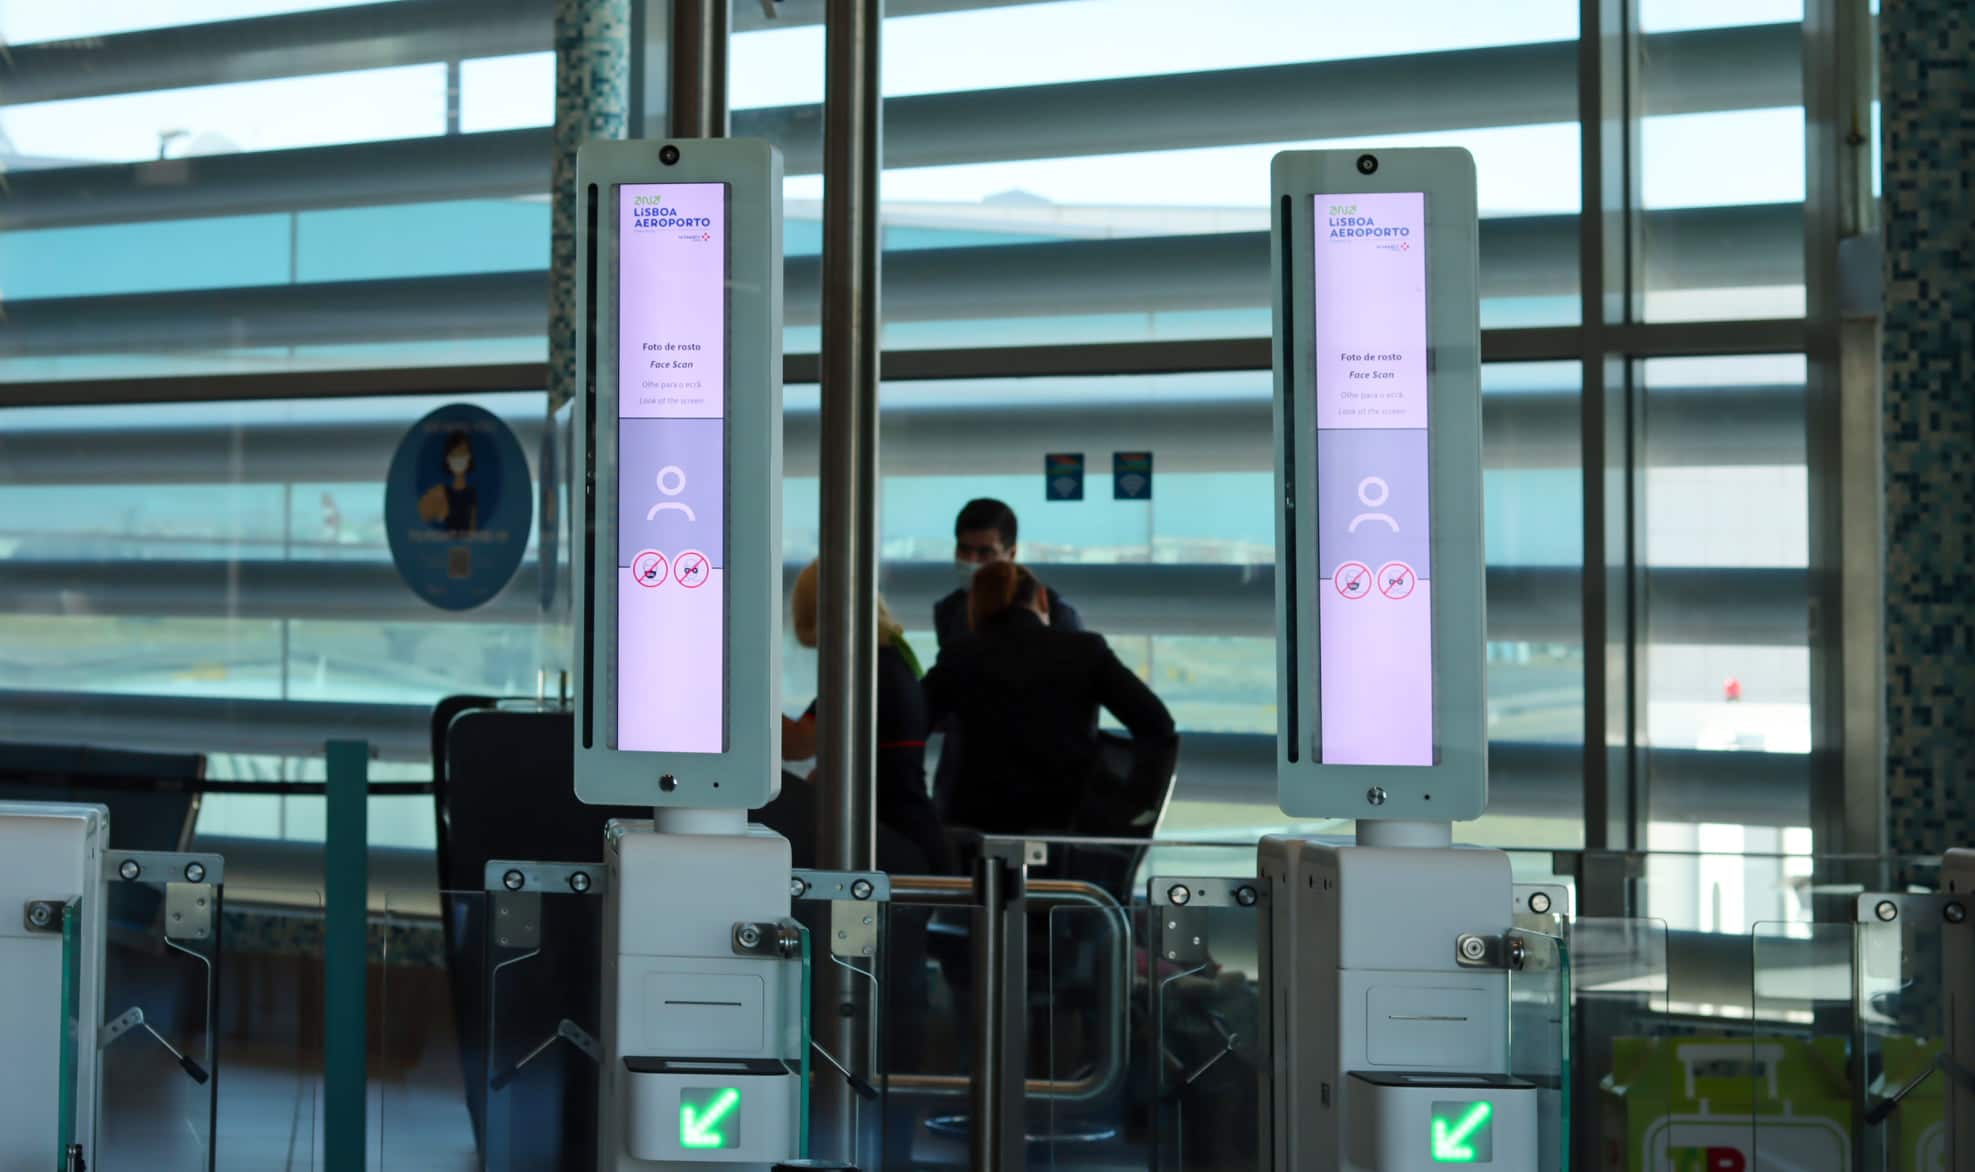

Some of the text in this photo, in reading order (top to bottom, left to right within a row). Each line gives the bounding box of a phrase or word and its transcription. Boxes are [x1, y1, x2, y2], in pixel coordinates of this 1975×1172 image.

[634, 217, 711, 228] AEROPORTO
[1329, 227, 1410, 238] AEROPORTO
[642, 342, 701, 351] Foto de rosto
[1341, 353, 1402, 361] Foto de rosto
[649, 360, 694, 369] Face Scan
[1348, 370, 1395, 379] Face Scan
